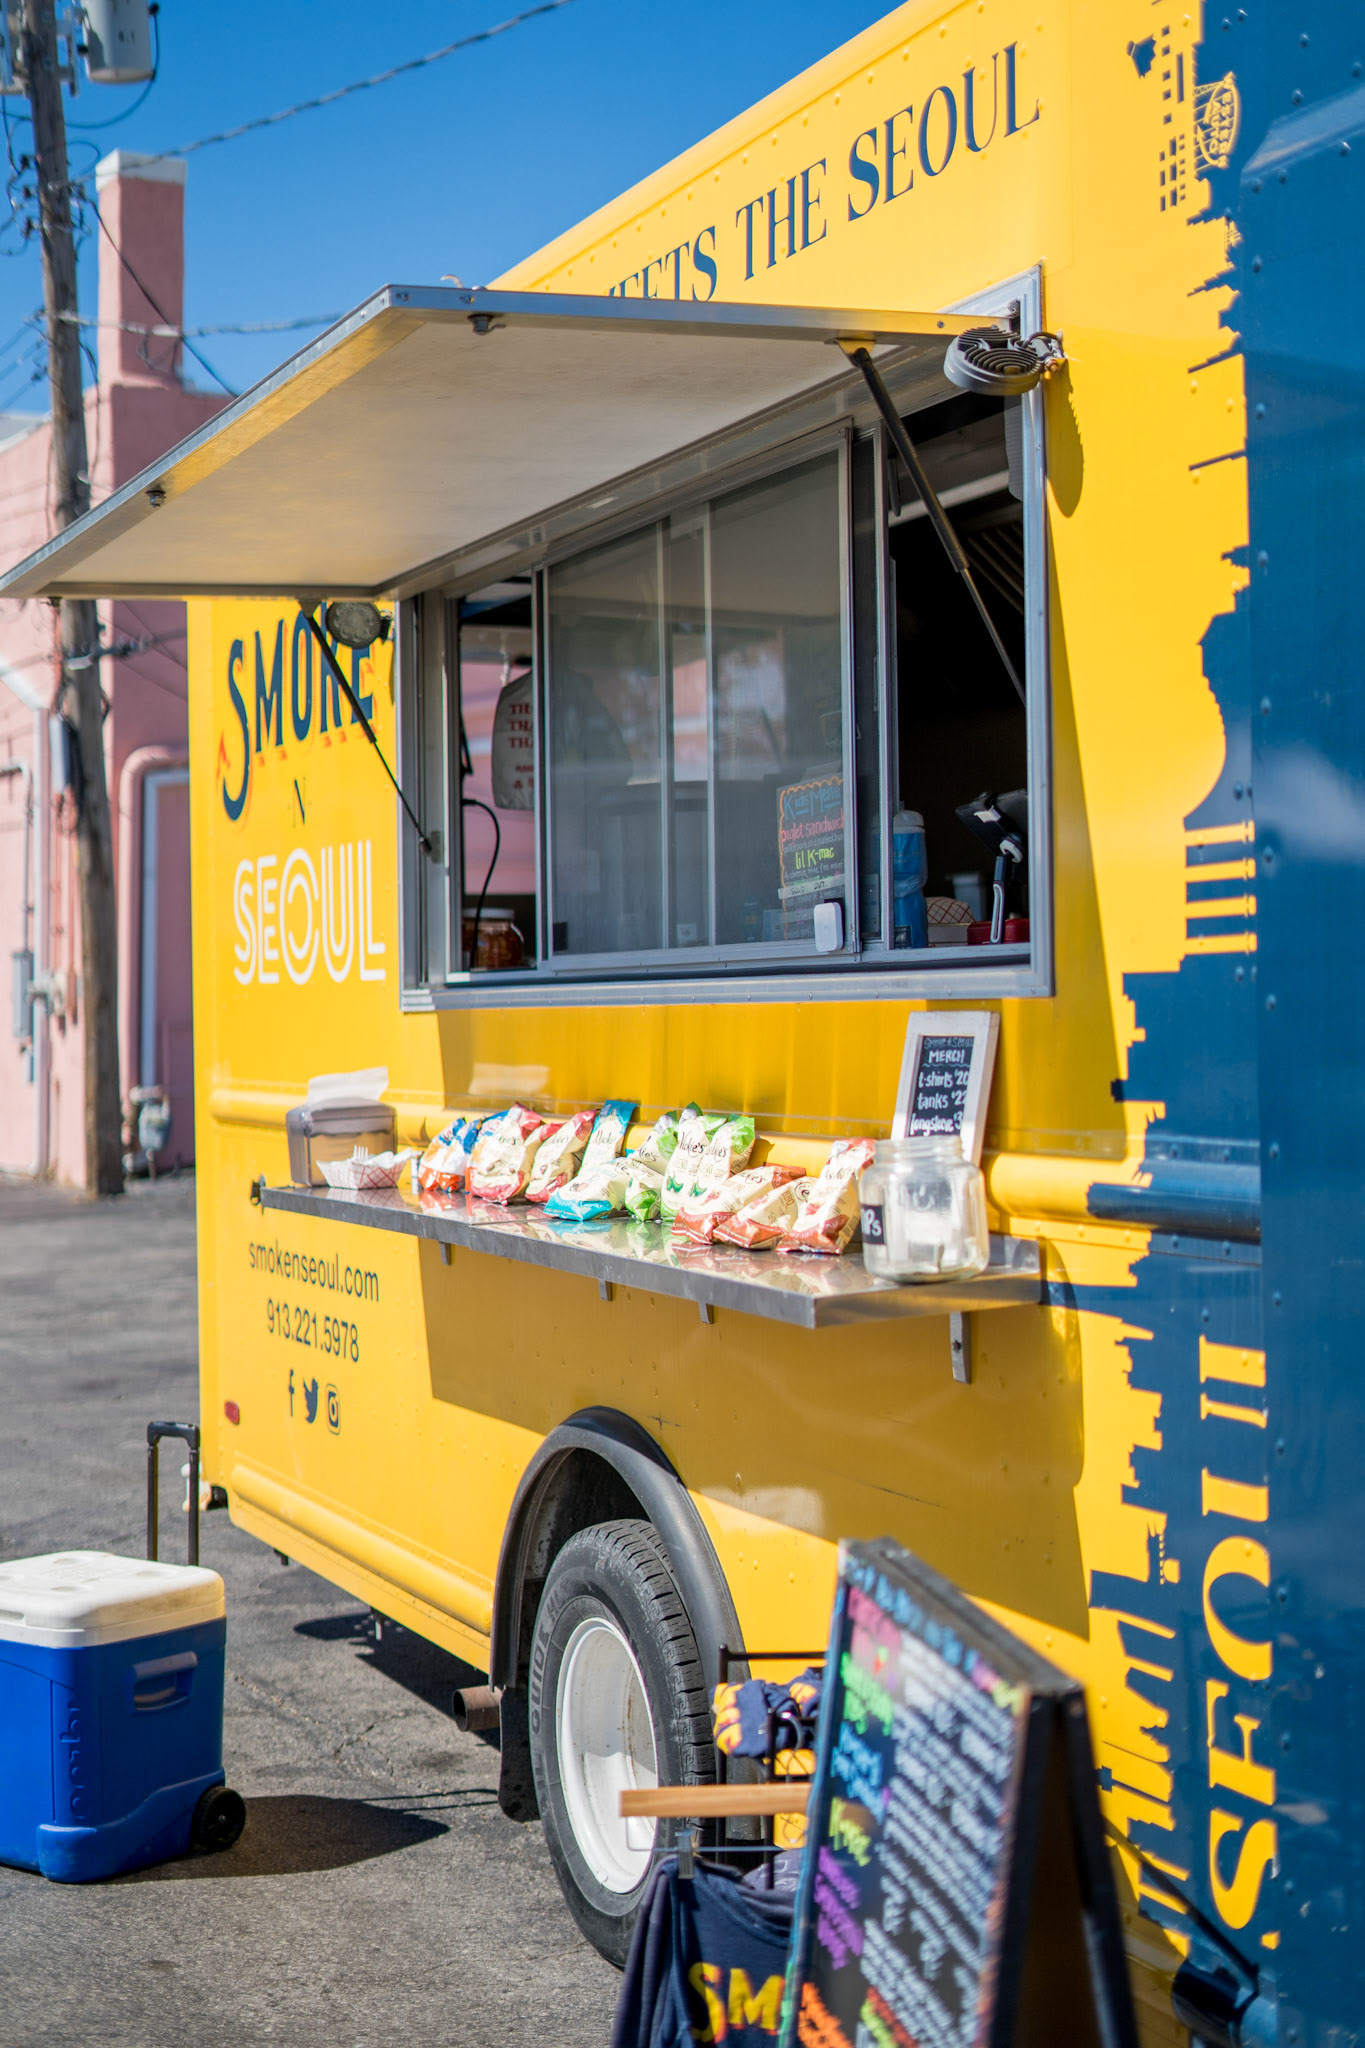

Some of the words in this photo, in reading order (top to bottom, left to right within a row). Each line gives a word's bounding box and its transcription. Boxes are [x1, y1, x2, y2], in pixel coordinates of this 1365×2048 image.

[735, 158, 827, 281] THE
[848, 41, 1040, 221] SEOUL
[233, 839, 387, 986] SEOUL
[928, 1050, 965, 1064] MERCH
[917, 1092, 949, 1111] tanks
[249, 1238, 380, 1303] smokenseoul.com
[266, 1297, 360, 1363] 913.221.5978
[529, 1624, 549, 1737] GUIDE
